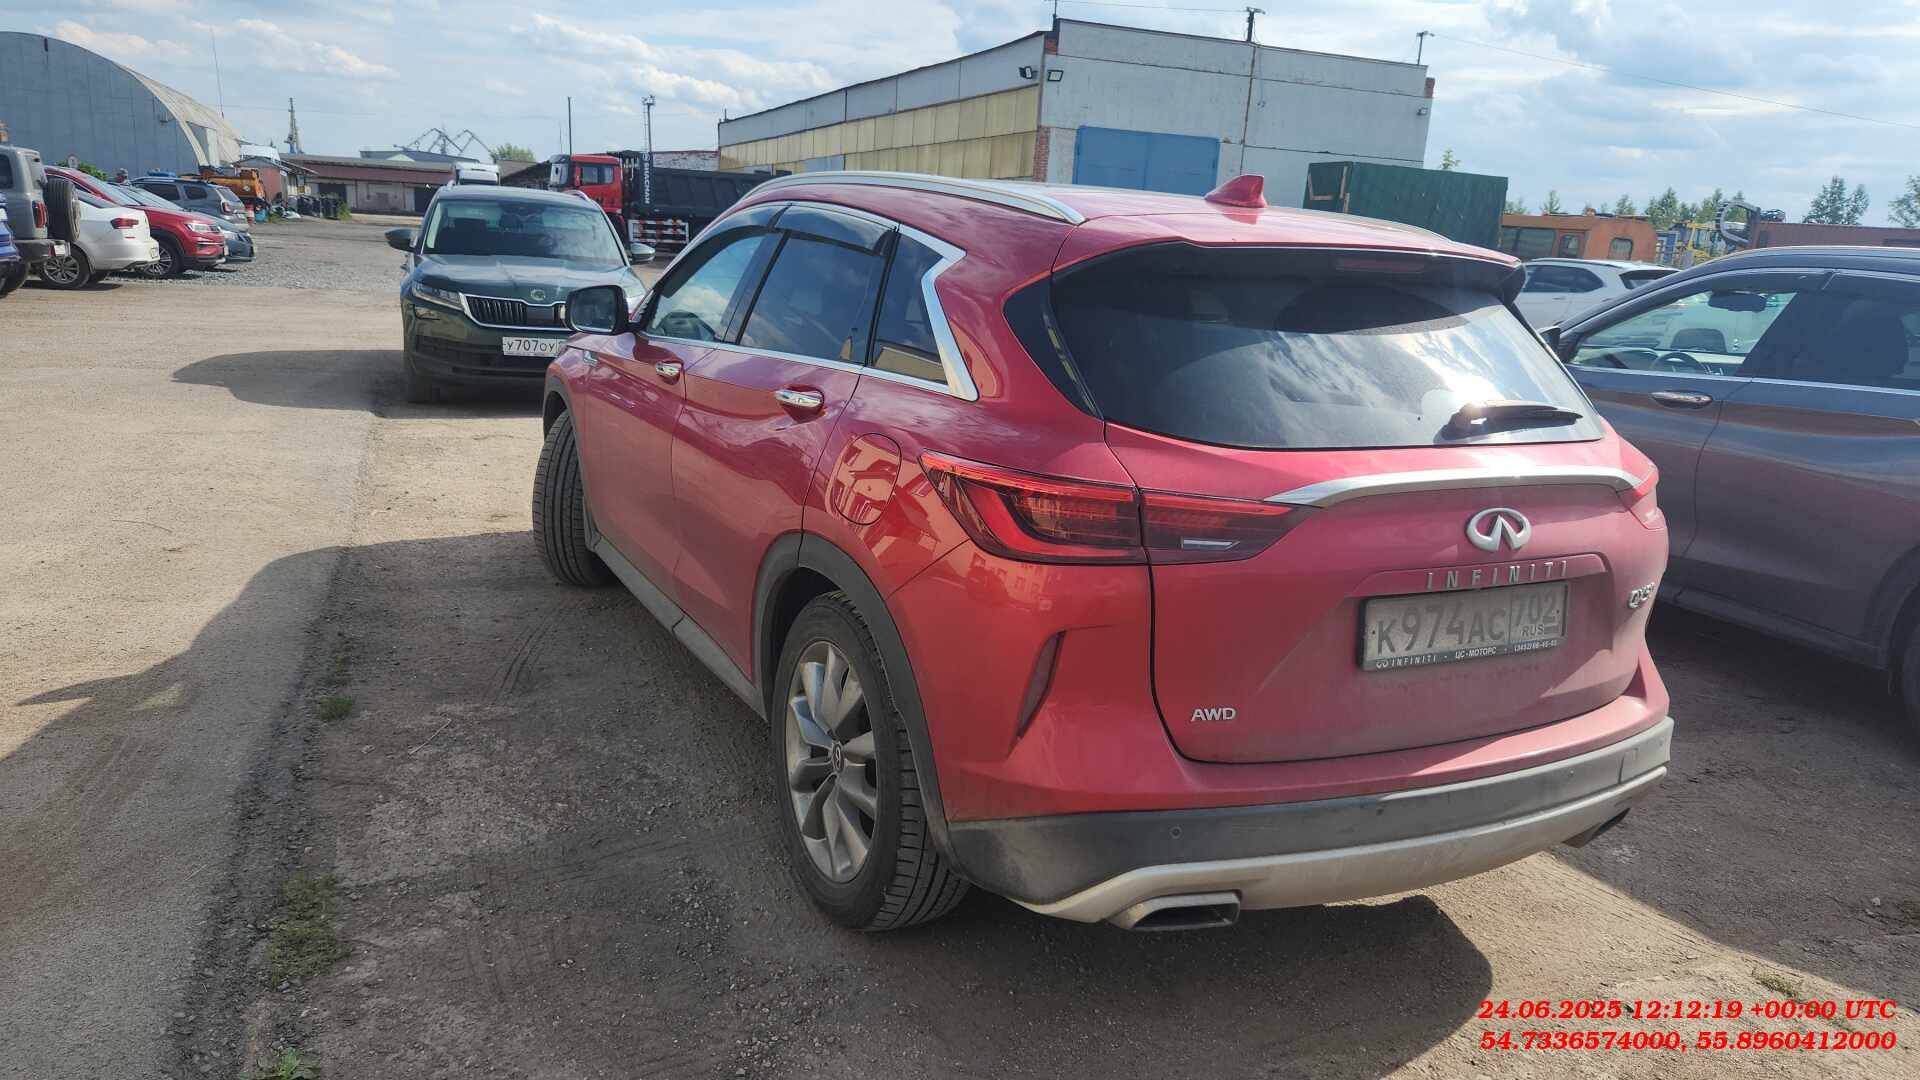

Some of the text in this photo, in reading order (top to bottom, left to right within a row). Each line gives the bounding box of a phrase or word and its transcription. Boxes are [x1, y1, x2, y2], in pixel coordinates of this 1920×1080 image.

[1425, 560, 1568, 591] INFINITI
[1521, 623, 1545, 637] RUS
[1391, 655, 1437, 667] INFINITI
[1190, 707, 1236, 722] AWD
